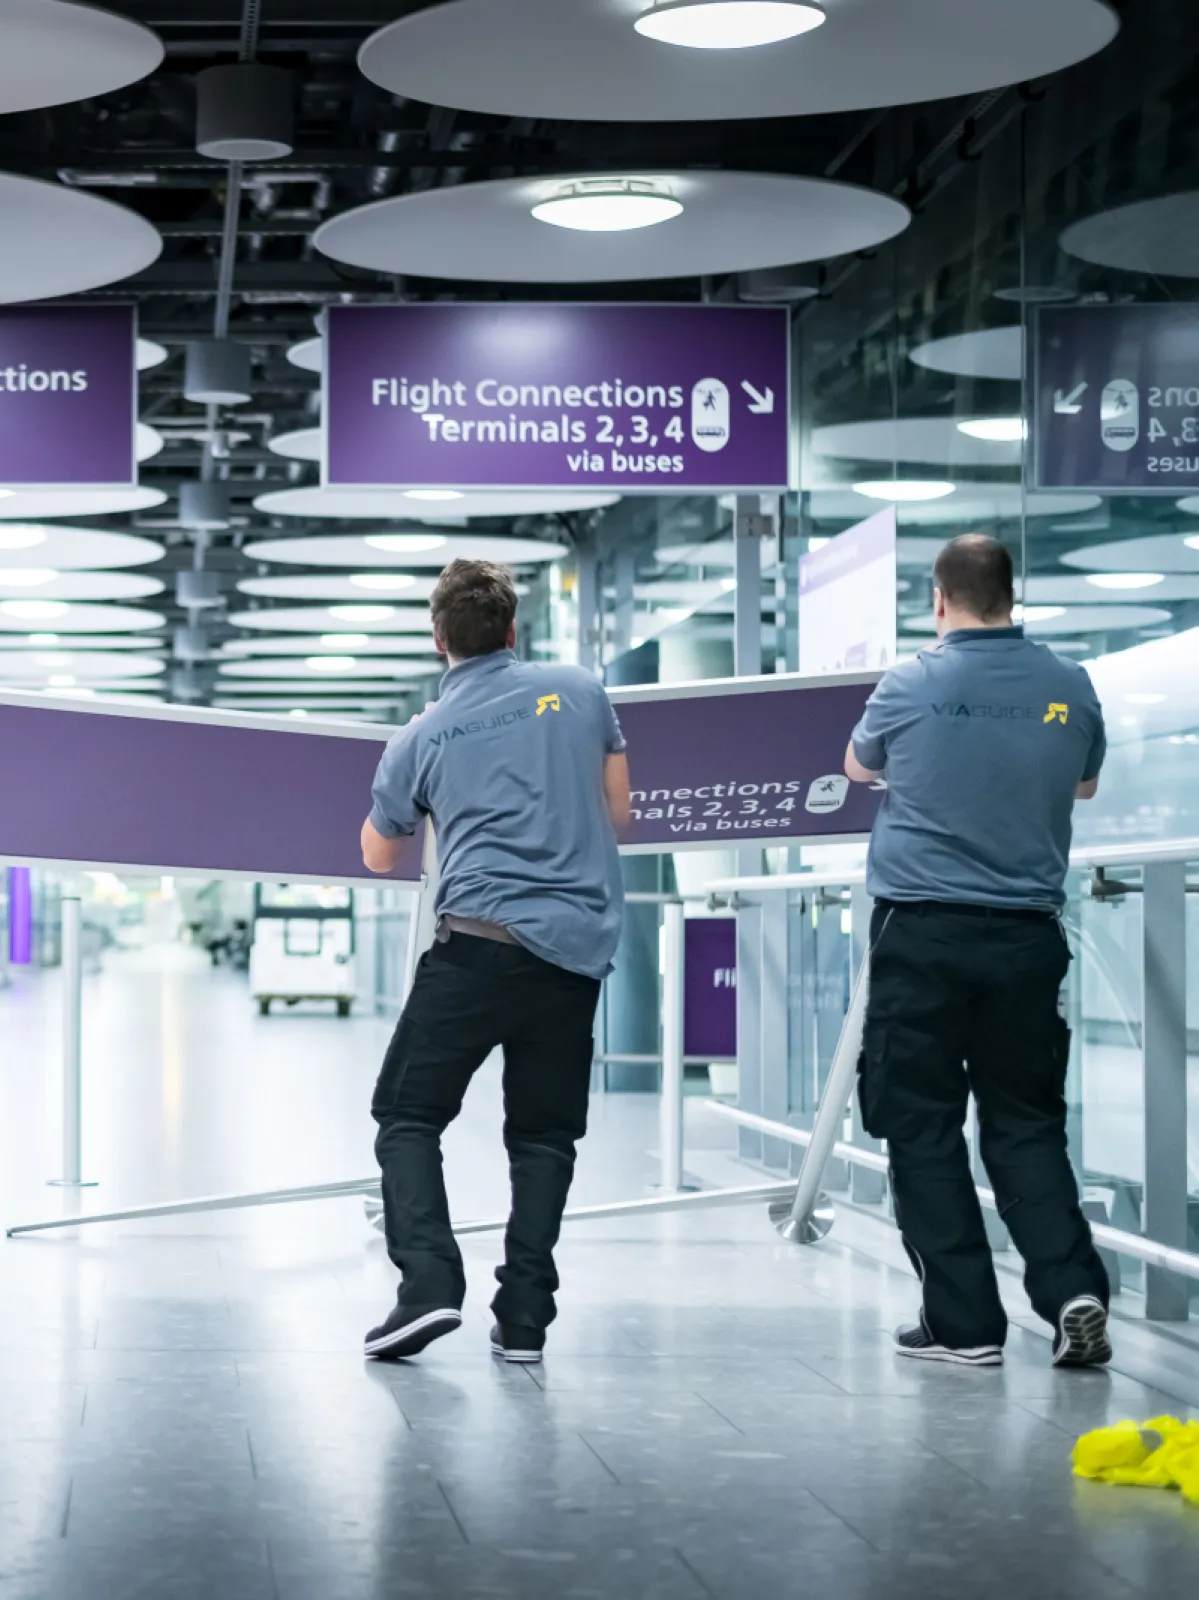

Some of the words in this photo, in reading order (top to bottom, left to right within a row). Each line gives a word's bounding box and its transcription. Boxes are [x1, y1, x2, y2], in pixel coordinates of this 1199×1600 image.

[372, 378, 467, 412] Flight
[476, 378, 684, 407] Connections
[421, 414, 586, 443] Terminals
[566, 450, 604, 472] via
[611, 450, 684, 473] buses
[930, 702, 1037, 720] VIAGUIDE
[428, 707, 532, 747] VIAGUIDE
[670, 819, 708, 833] via
[715, 816, 792, 831] buses
